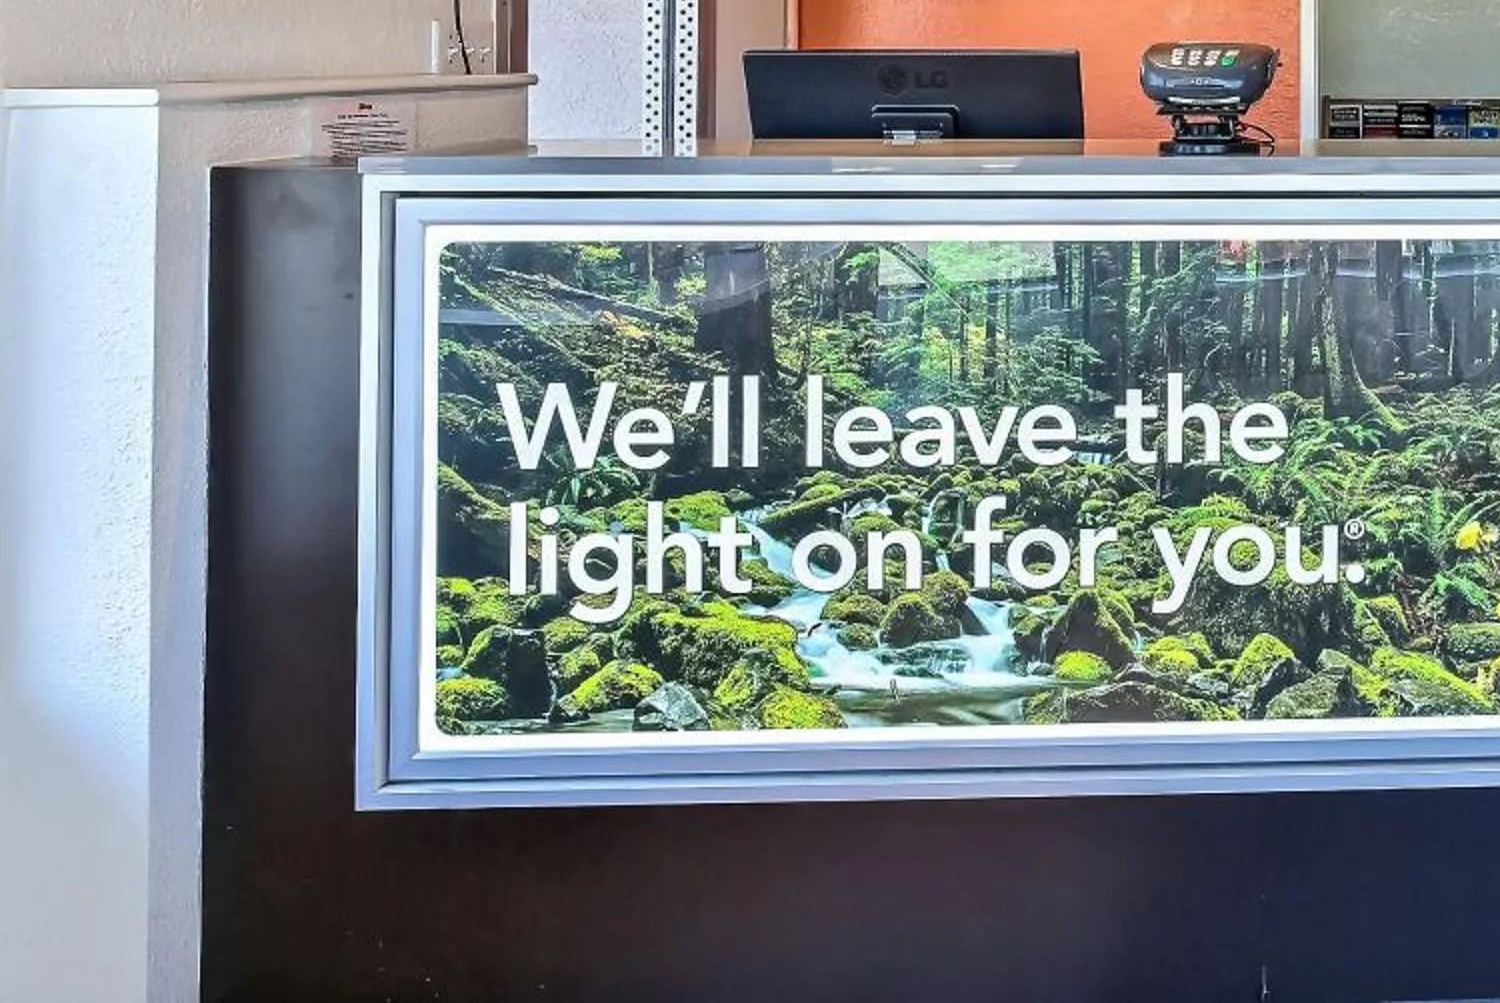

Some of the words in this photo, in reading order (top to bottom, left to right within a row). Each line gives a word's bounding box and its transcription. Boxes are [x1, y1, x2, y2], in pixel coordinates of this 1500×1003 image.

[914, 71, 949, 89] LG
[496, 374, 760, 470] We'll
[805, 374, 1076, 469] leave
[1115, 372, 1290, 464] the
[509, 500, 755, 625] light
[791, 529, 923, 594] on
[963, 497, 1118, 590] for
